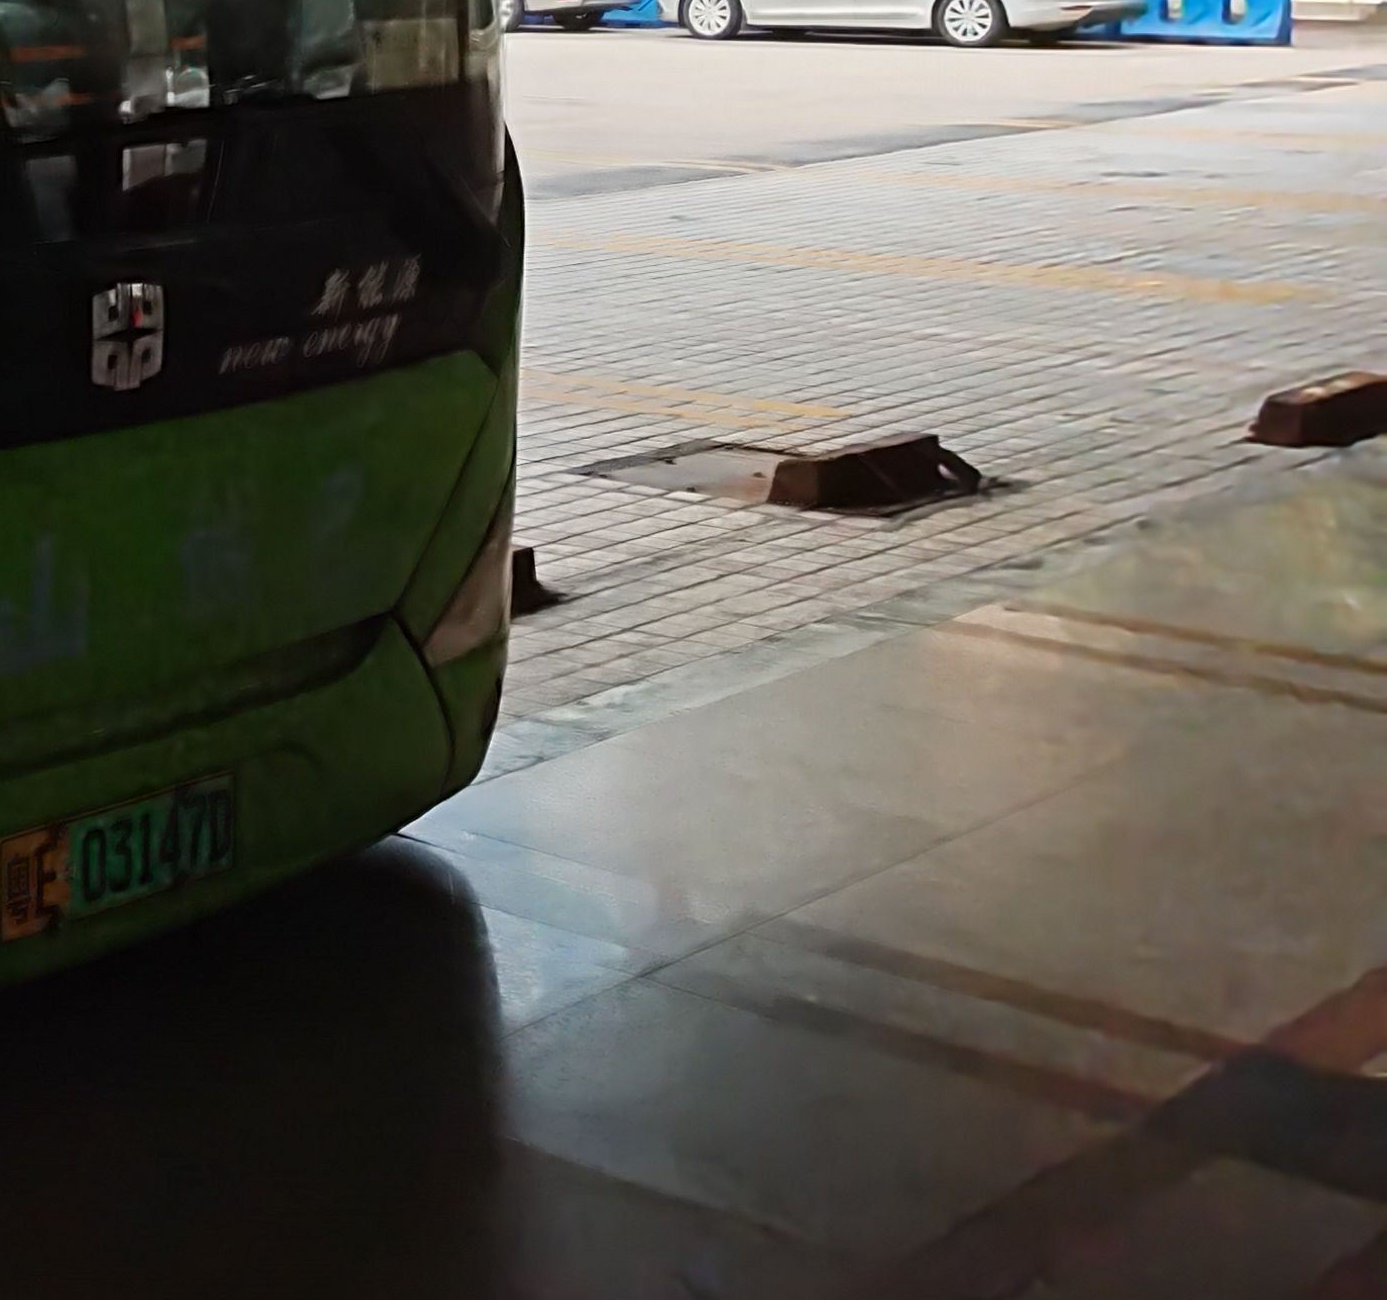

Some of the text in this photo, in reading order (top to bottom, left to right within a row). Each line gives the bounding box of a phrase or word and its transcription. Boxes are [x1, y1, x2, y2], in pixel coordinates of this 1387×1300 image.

[312, 253, 422, 316] 新能源
[219, 314, 402, 375] new energy
